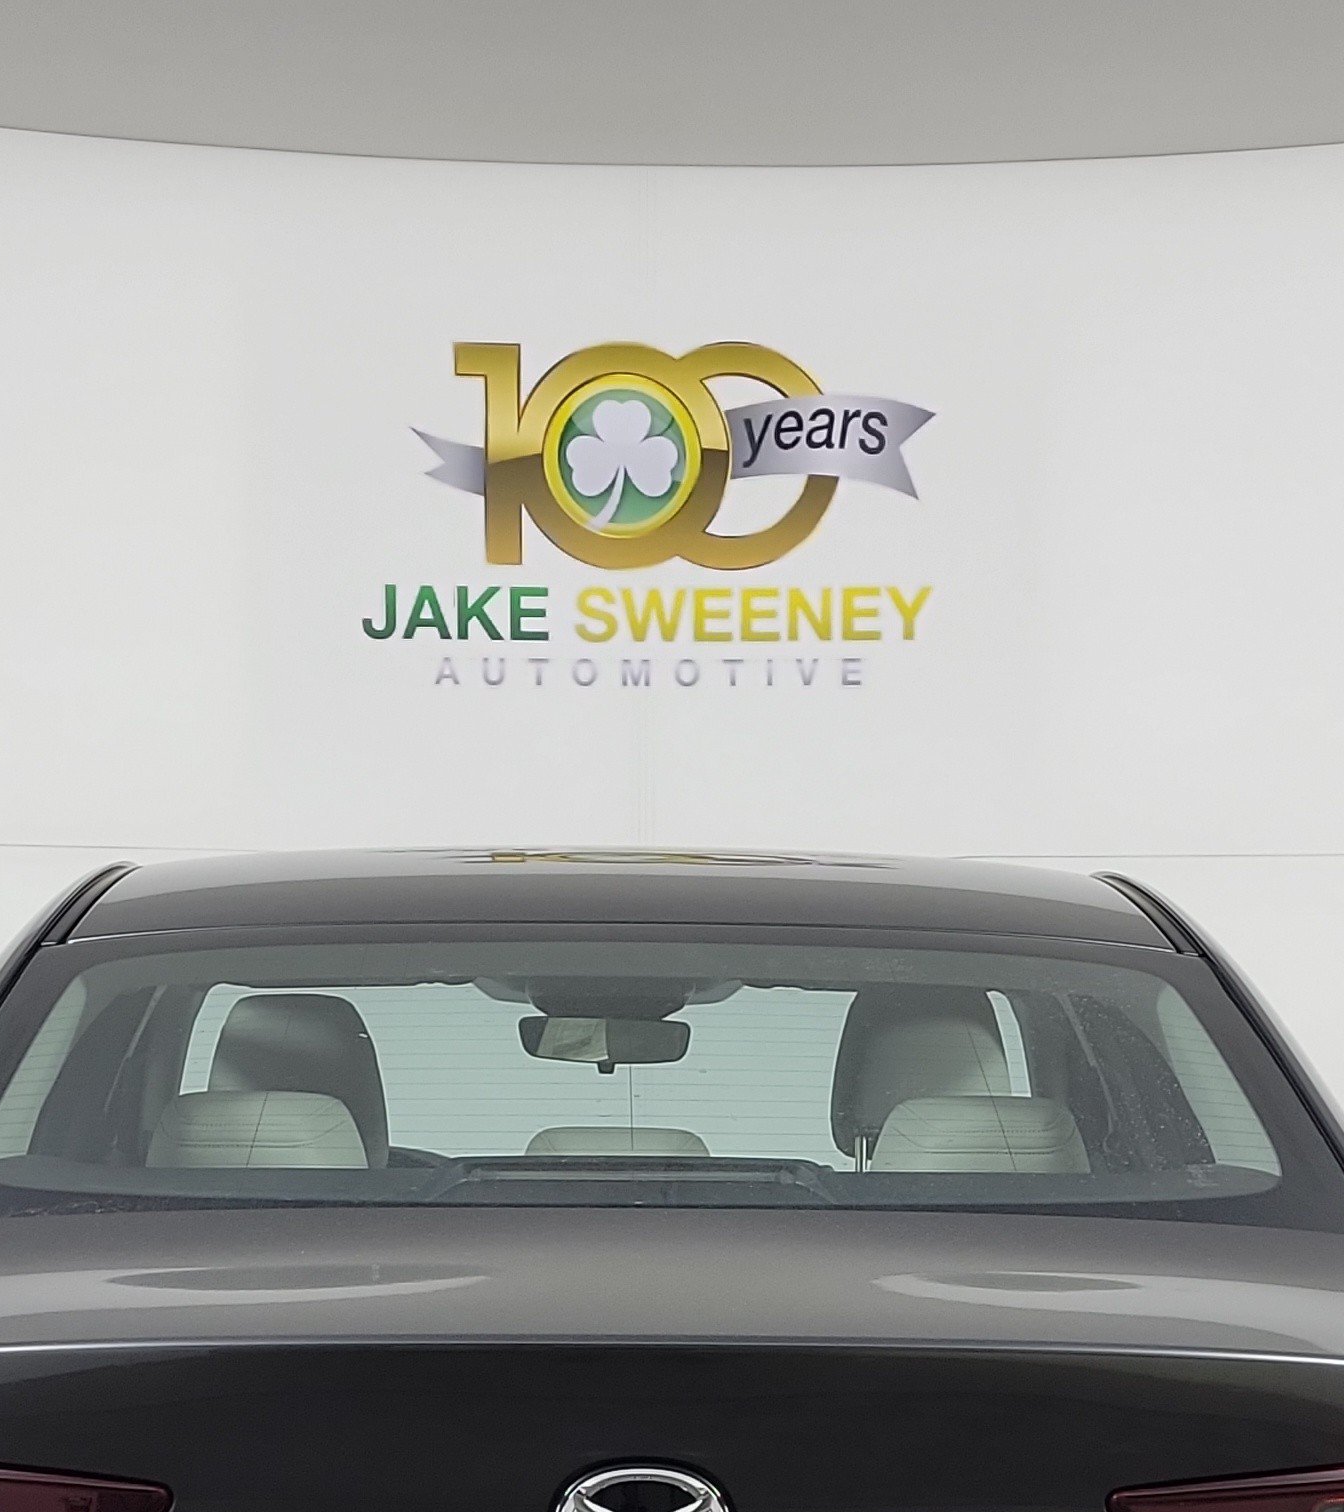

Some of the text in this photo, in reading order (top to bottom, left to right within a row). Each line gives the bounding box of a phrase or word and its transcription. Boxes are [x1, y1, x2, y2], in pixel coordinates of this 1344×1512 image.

[743, 406, 889, 467] years
[362, 584, 933, 643] JAKE SWEENEY
[434, 657, 864, 687] AUTOMOTIVE
